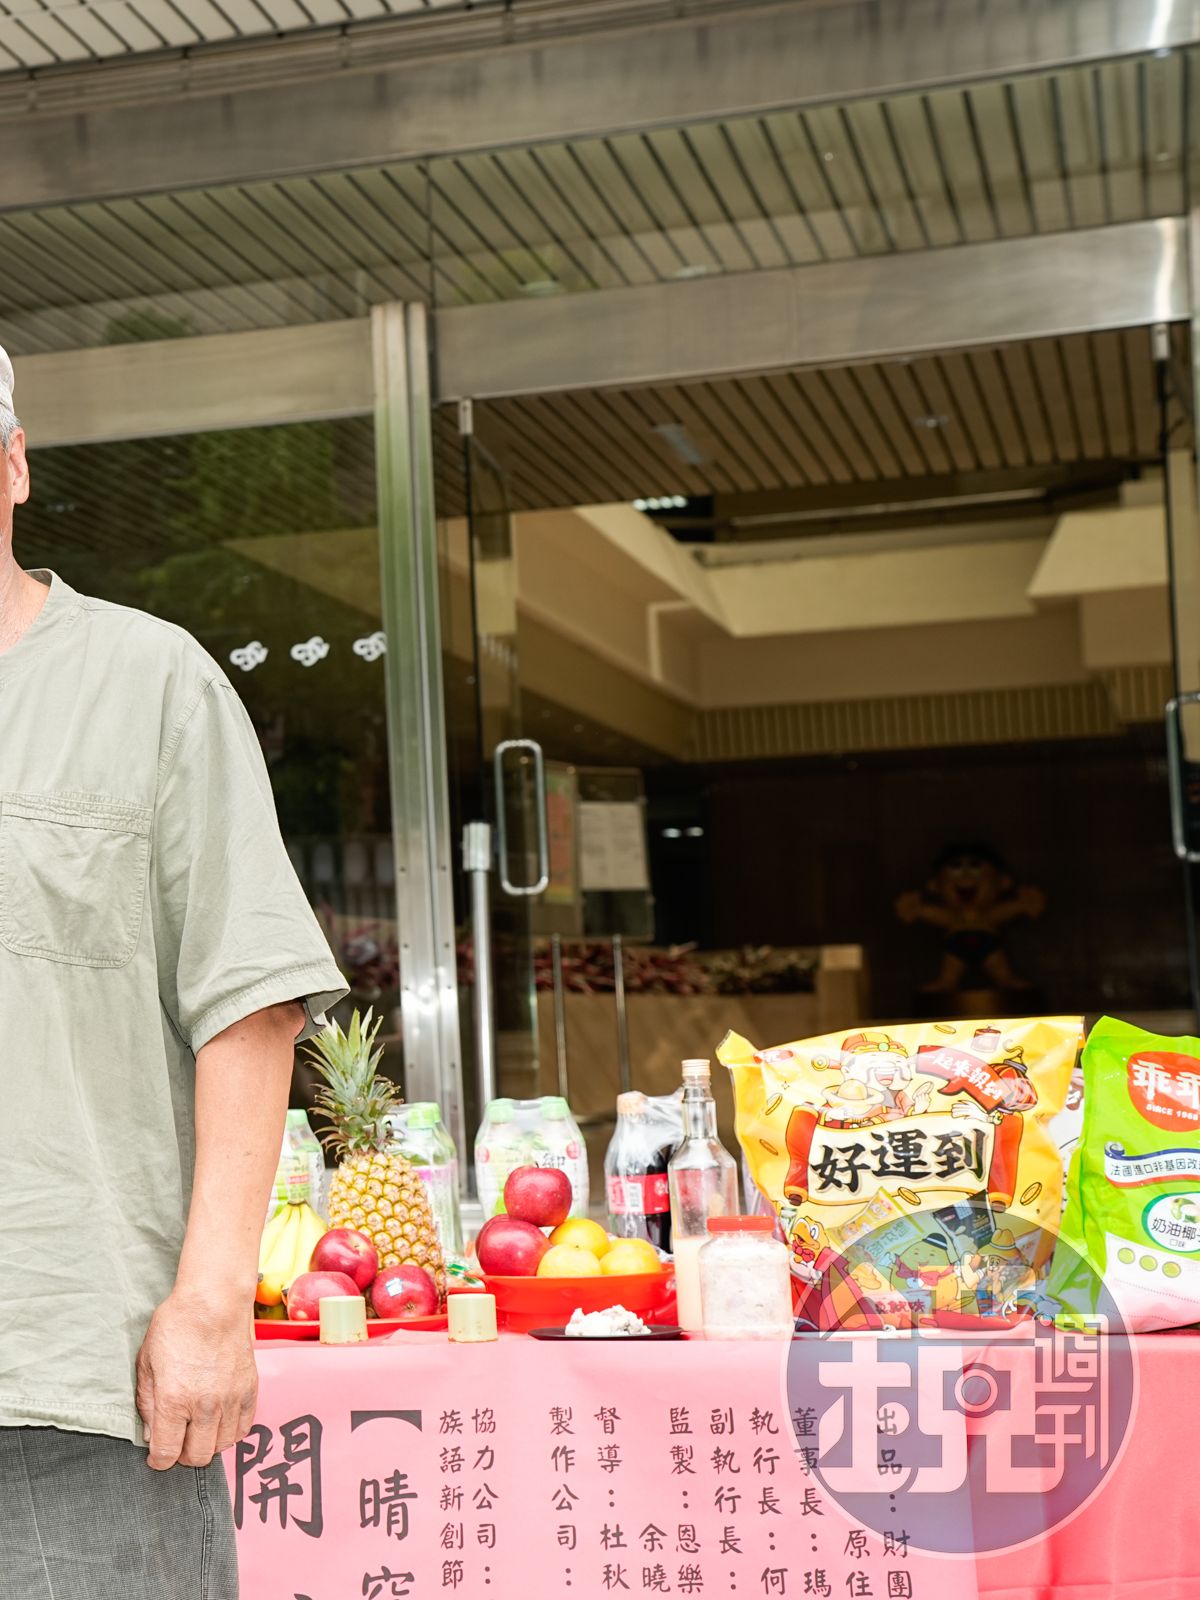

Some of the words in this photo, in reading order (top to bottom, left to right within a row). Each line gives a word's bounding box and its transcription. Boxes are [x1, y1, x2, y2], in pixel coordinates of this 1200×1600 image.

[810, 1128, 987, 1193] 好運到
[1110, 1157, 1200, 1177] 法國進口非基因改
[234, 1413, 323, 1600] 開
[439, 1409, 465, 1589] 族語新創節
[843, 1529, 873, 1598] 原住
